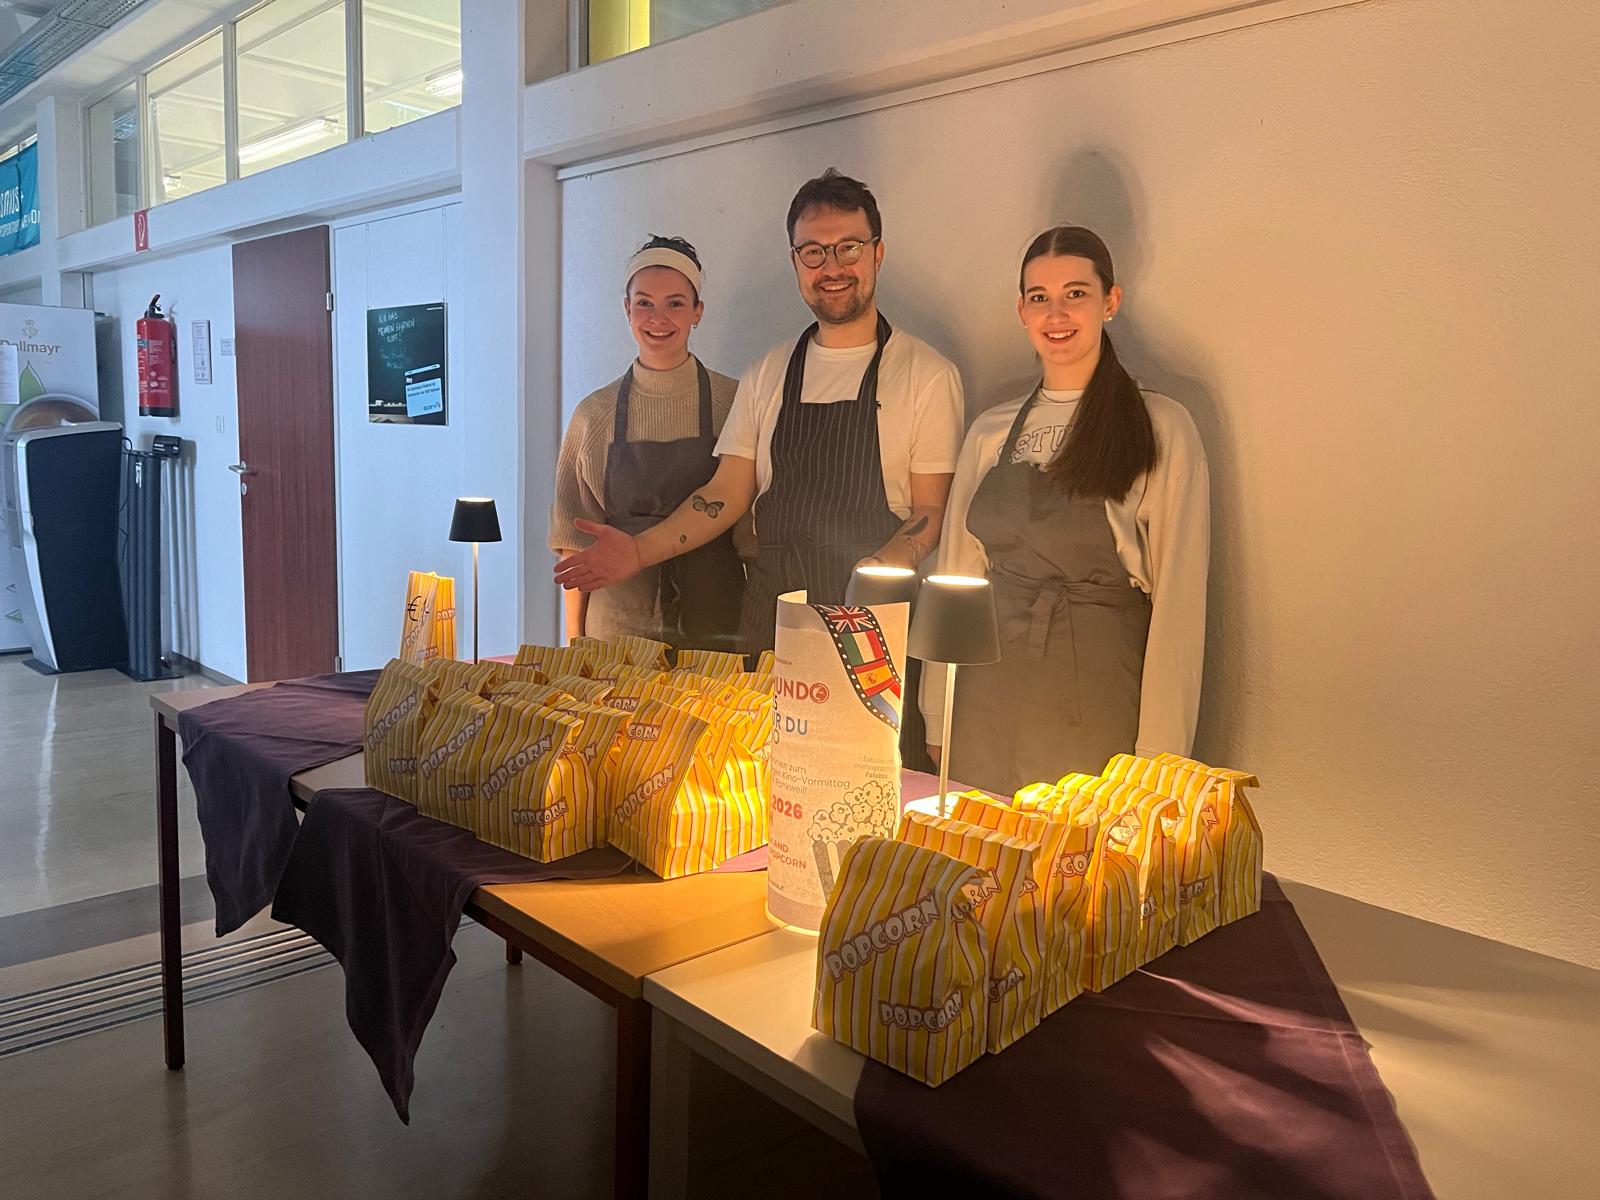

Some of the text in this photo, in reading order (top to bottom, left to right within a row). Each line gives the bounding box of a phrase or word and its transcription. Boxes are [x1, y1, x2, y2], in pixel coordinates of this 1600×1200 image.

[0, 340, 61, 355] llmayr
[367, 690, 419, 751] POPCORN
[785, 716, 808, 736] DU
[420, 711, 486, 779] POPCORN
[481, 735, 553, 801] POPCORN
[782, 771, 850, 790] Kino-Vormittag
[790, 764, 807, 775] zum
[512, 796, 568, 827] POPCORN
[614, 763, 675, 824] POPCORN
[772, 793, 803, 820] 2026
[825, 890, 940, 984] POPCORN
[879, 989, 963, 1034] POPCORN
